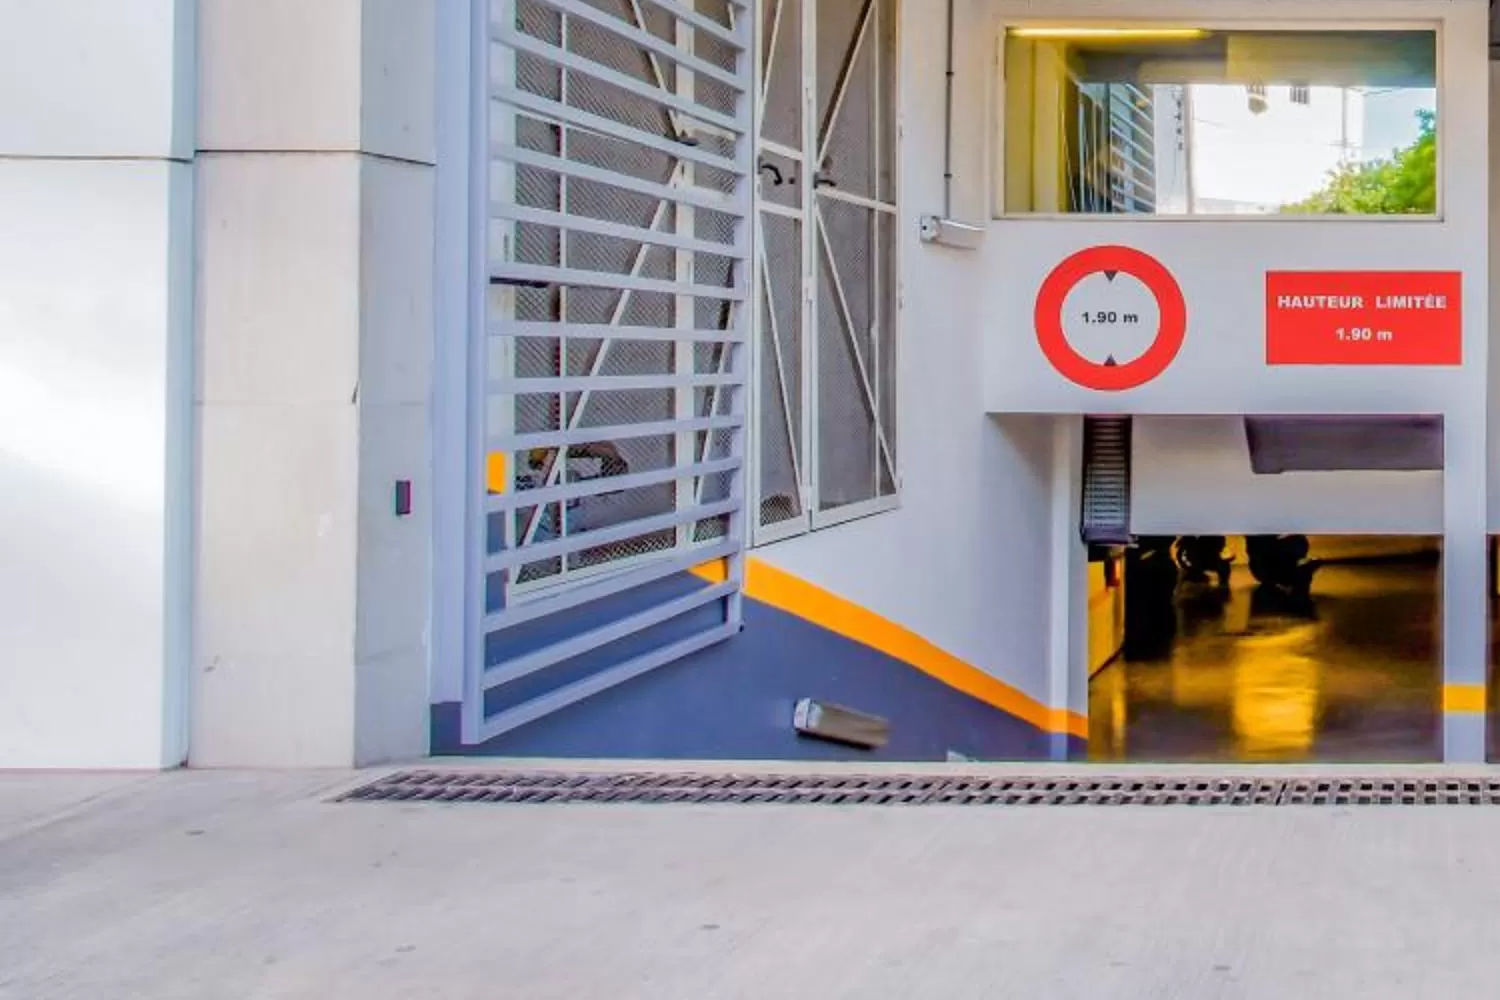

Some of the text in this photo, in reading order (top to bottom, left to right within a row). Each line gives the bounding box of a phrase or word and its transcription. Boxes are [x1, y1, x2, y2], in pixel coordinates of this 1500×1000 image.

[1277, 293, 1447, 309] HAUTEUR LIMITÉE
[1081, 311, 1138, 324] 1.90 m
[1335, 327, 1393, 341] 1.90 m
